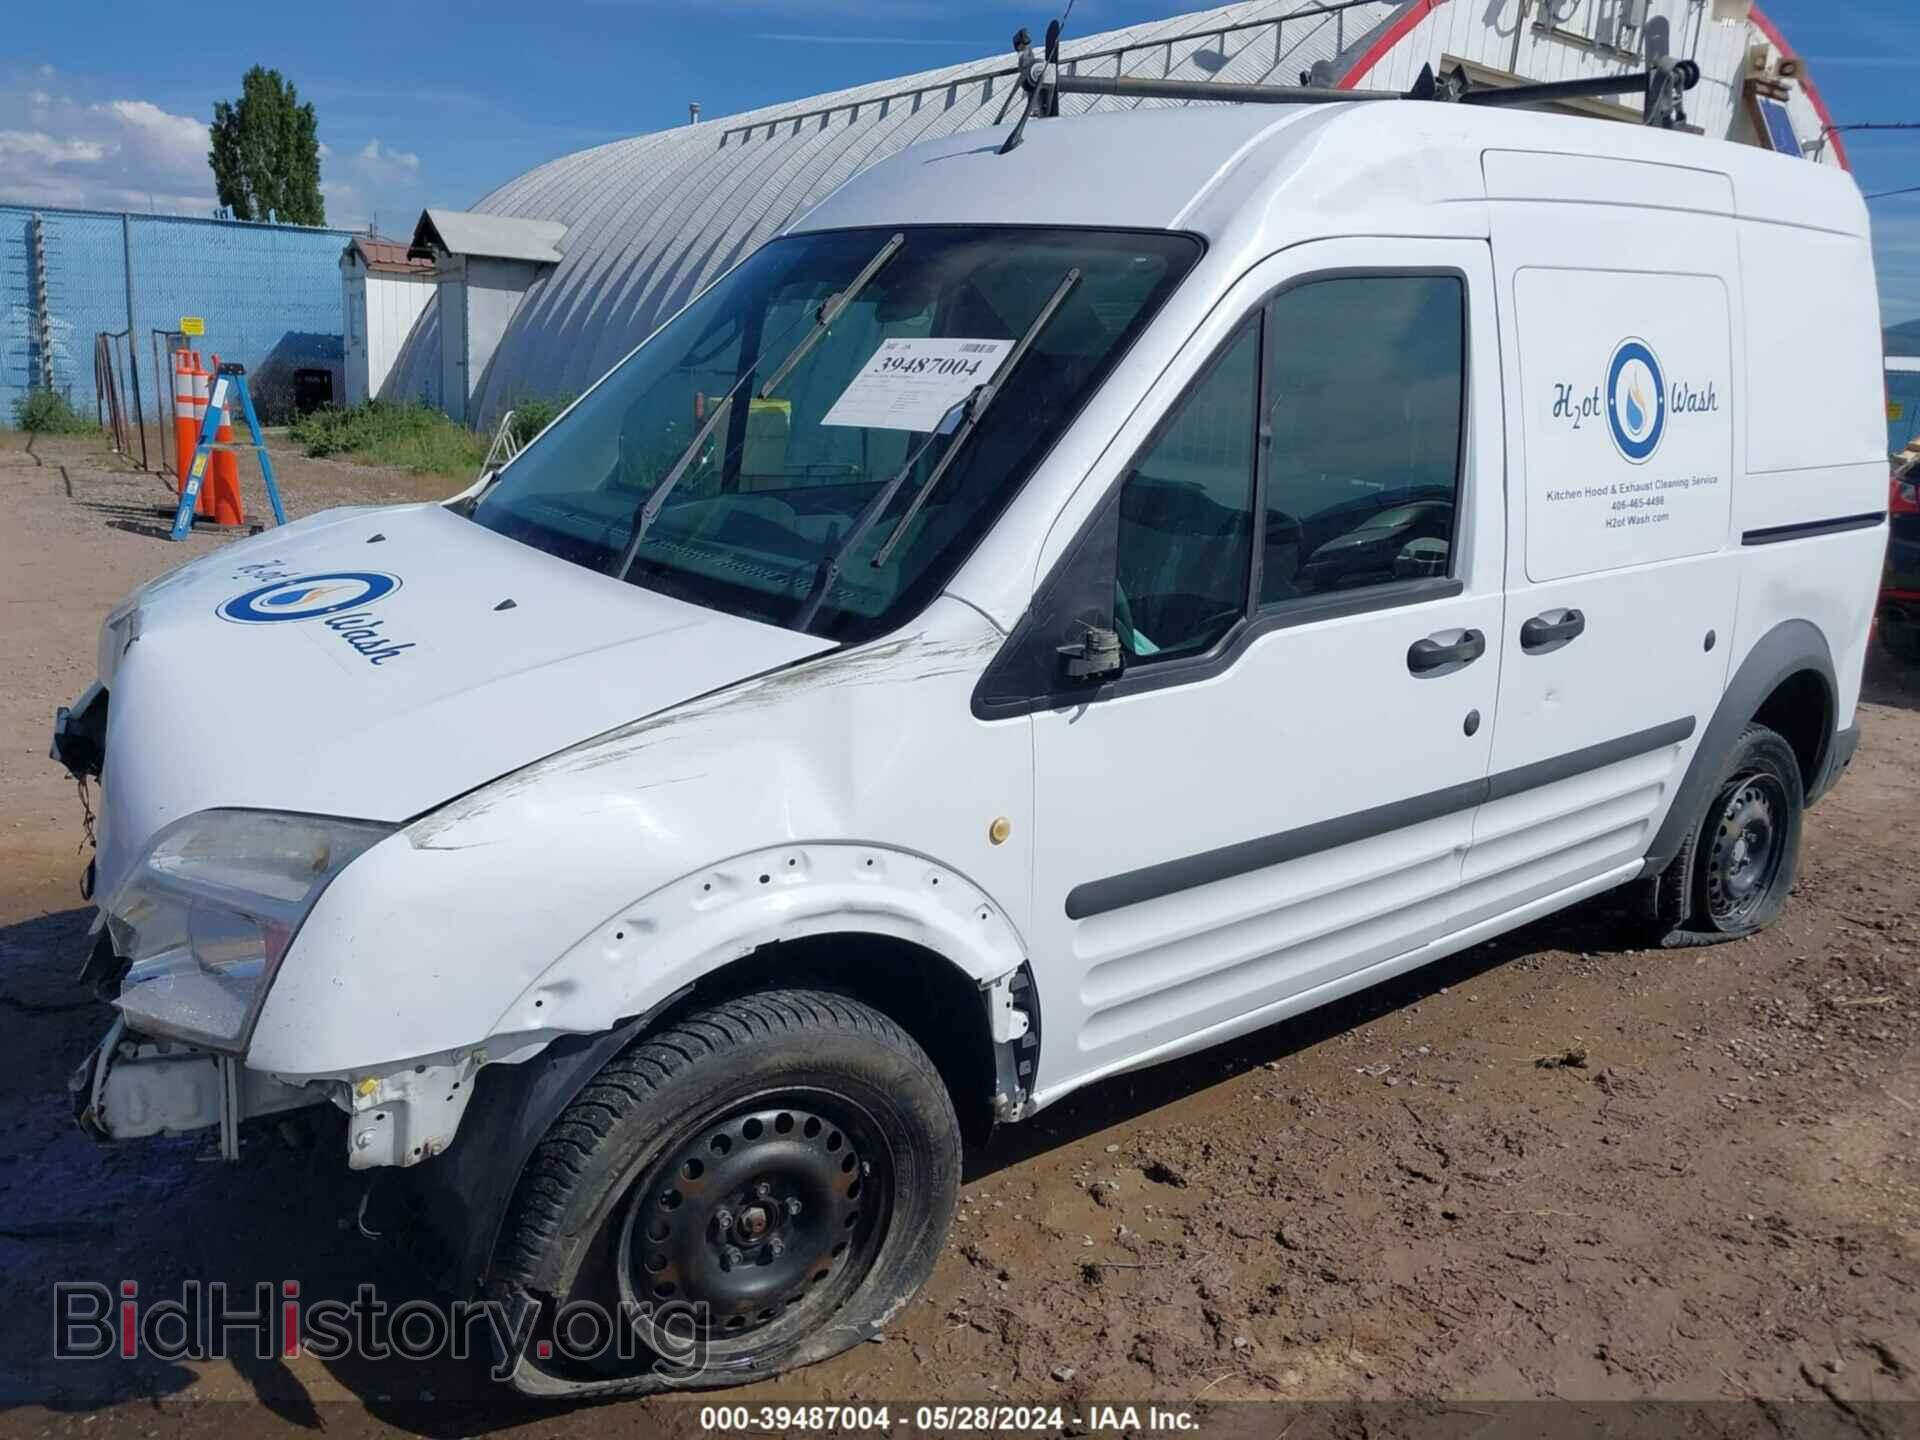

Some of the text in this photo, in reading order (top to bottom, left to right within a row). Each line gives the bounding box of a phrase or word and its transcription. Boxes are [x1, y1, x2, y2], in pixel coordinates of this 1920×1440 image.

[873, 356, 983, 376] 39487004
[1671, 380, 1719, 413] Wash
[1546, 475, 1719, 502] Kitchen Hood & Exhaust Cleaning Service
[323, 612, 416, 666] Wash
